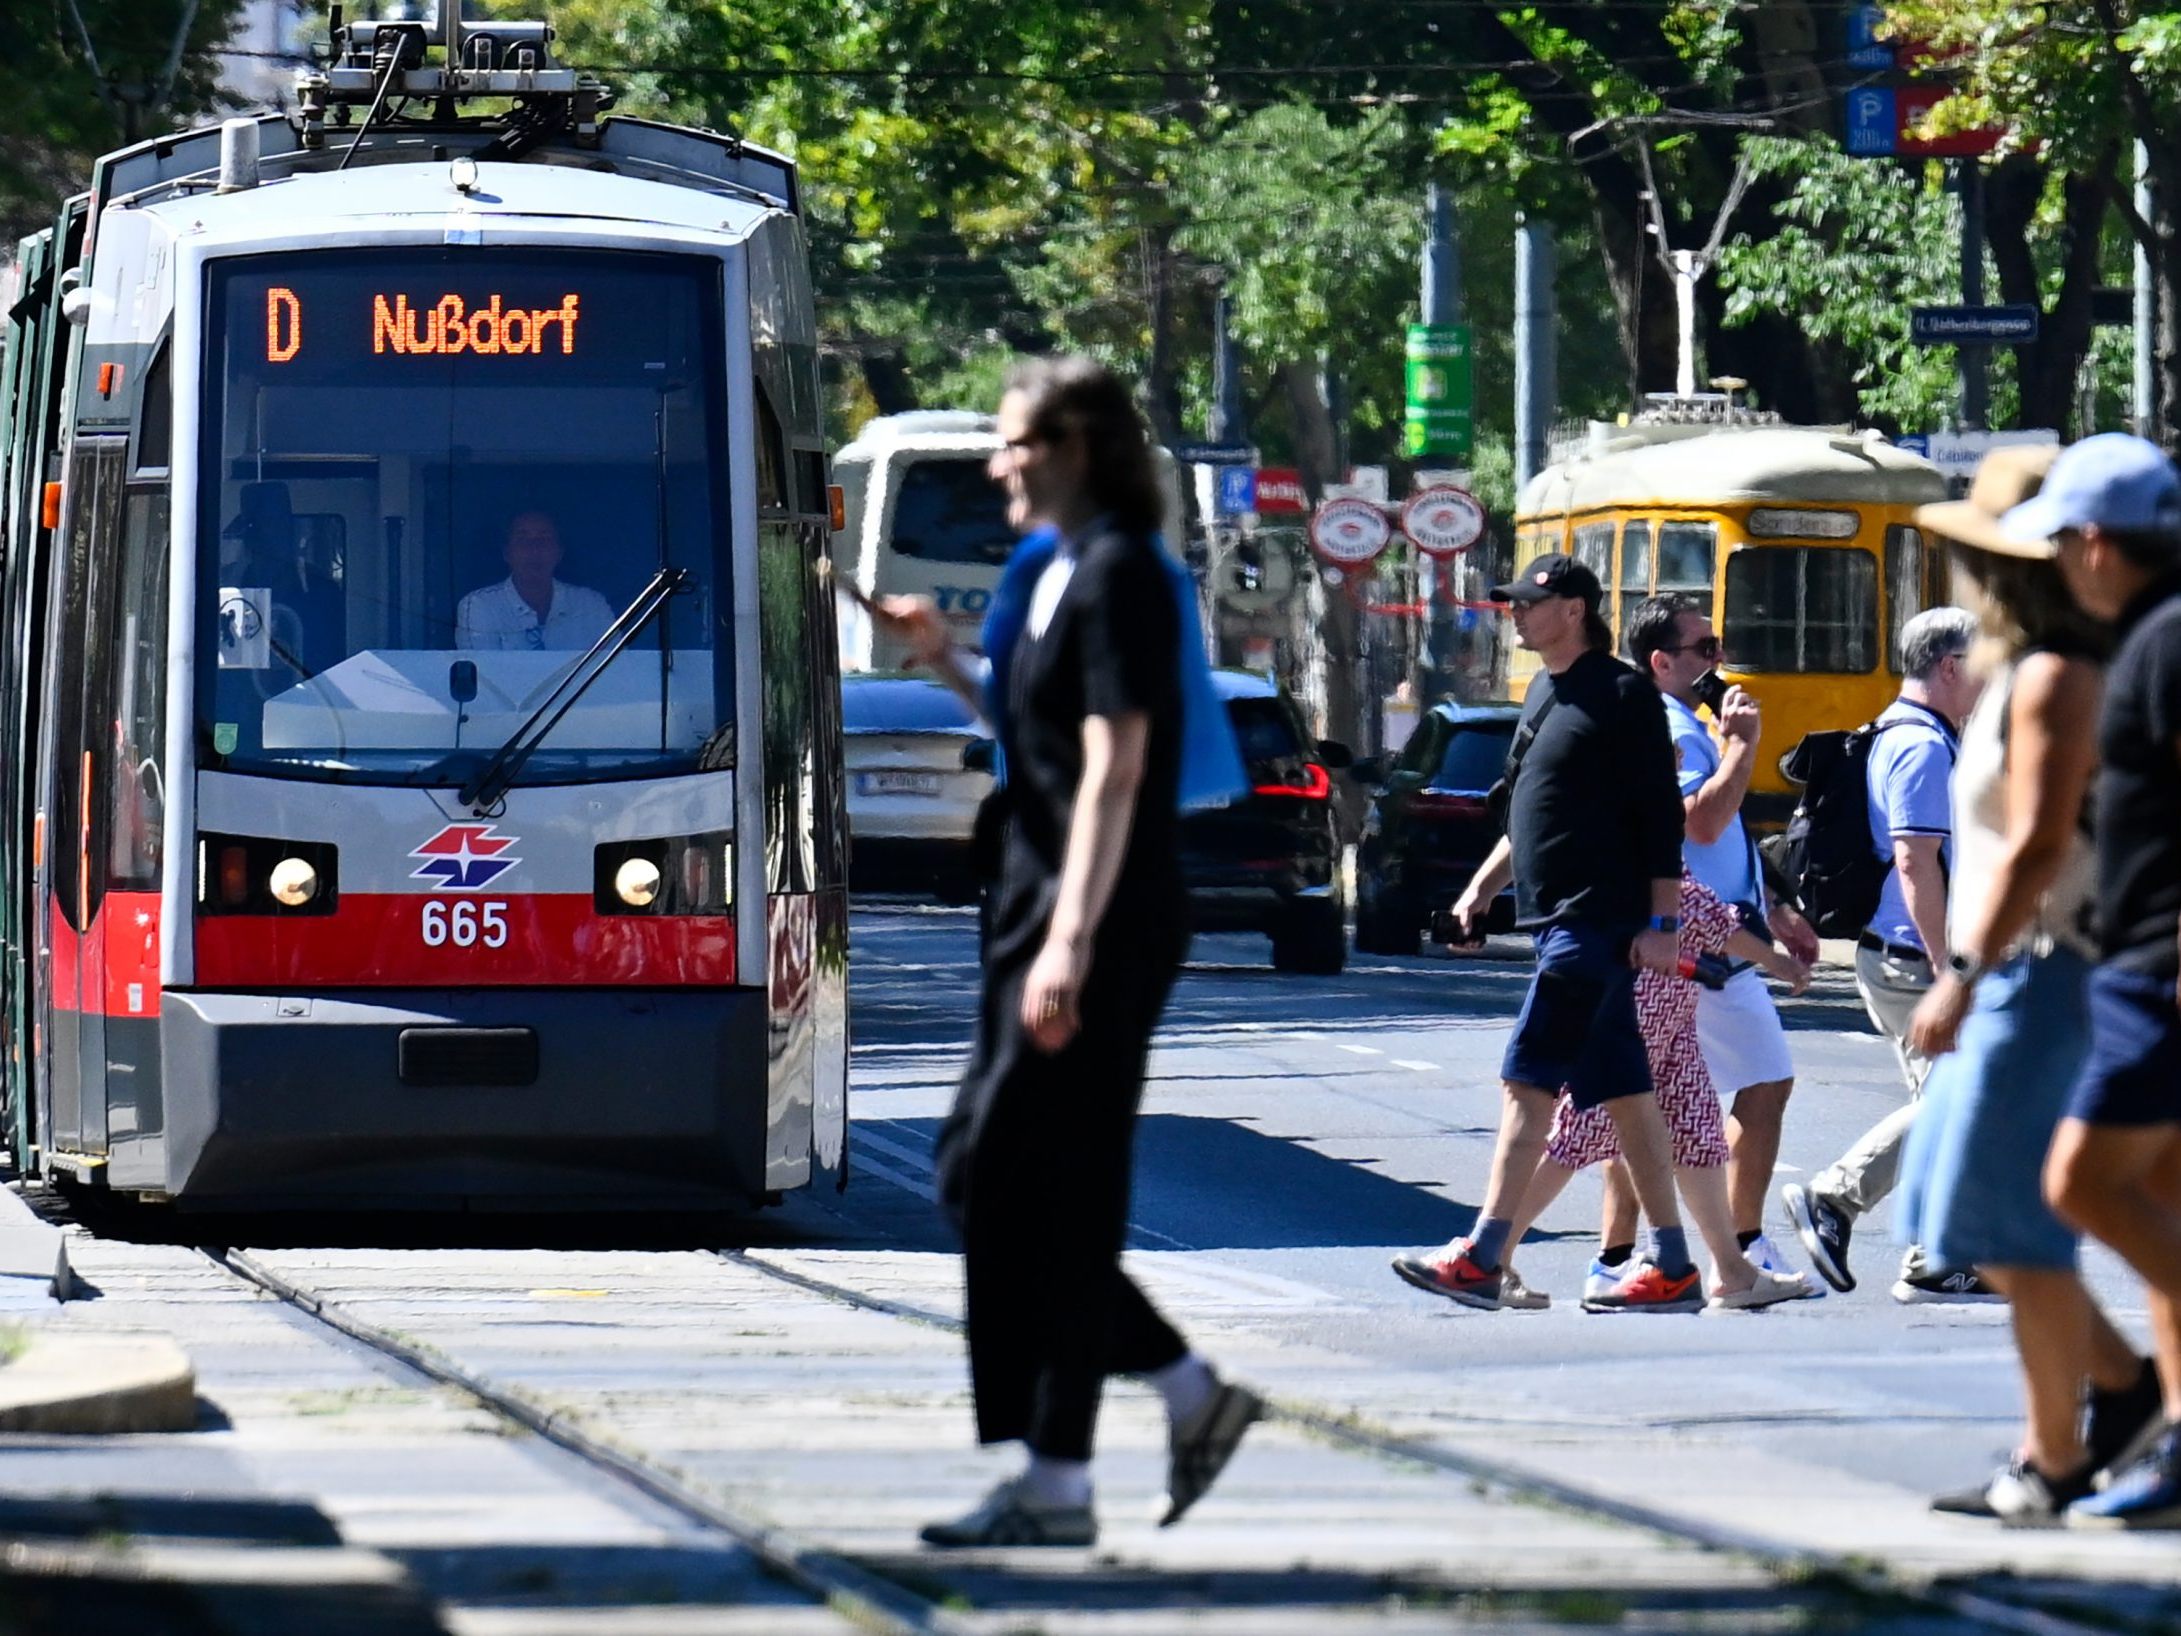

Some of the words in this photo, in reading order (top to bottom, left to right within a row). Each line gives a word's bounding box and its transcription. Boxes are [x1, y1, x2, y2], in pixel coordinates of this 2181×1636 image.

[267, 287, 300, 362] D
[374, 294, 579, 354] Nußdorf
[422, 900, 507, 948] 665
